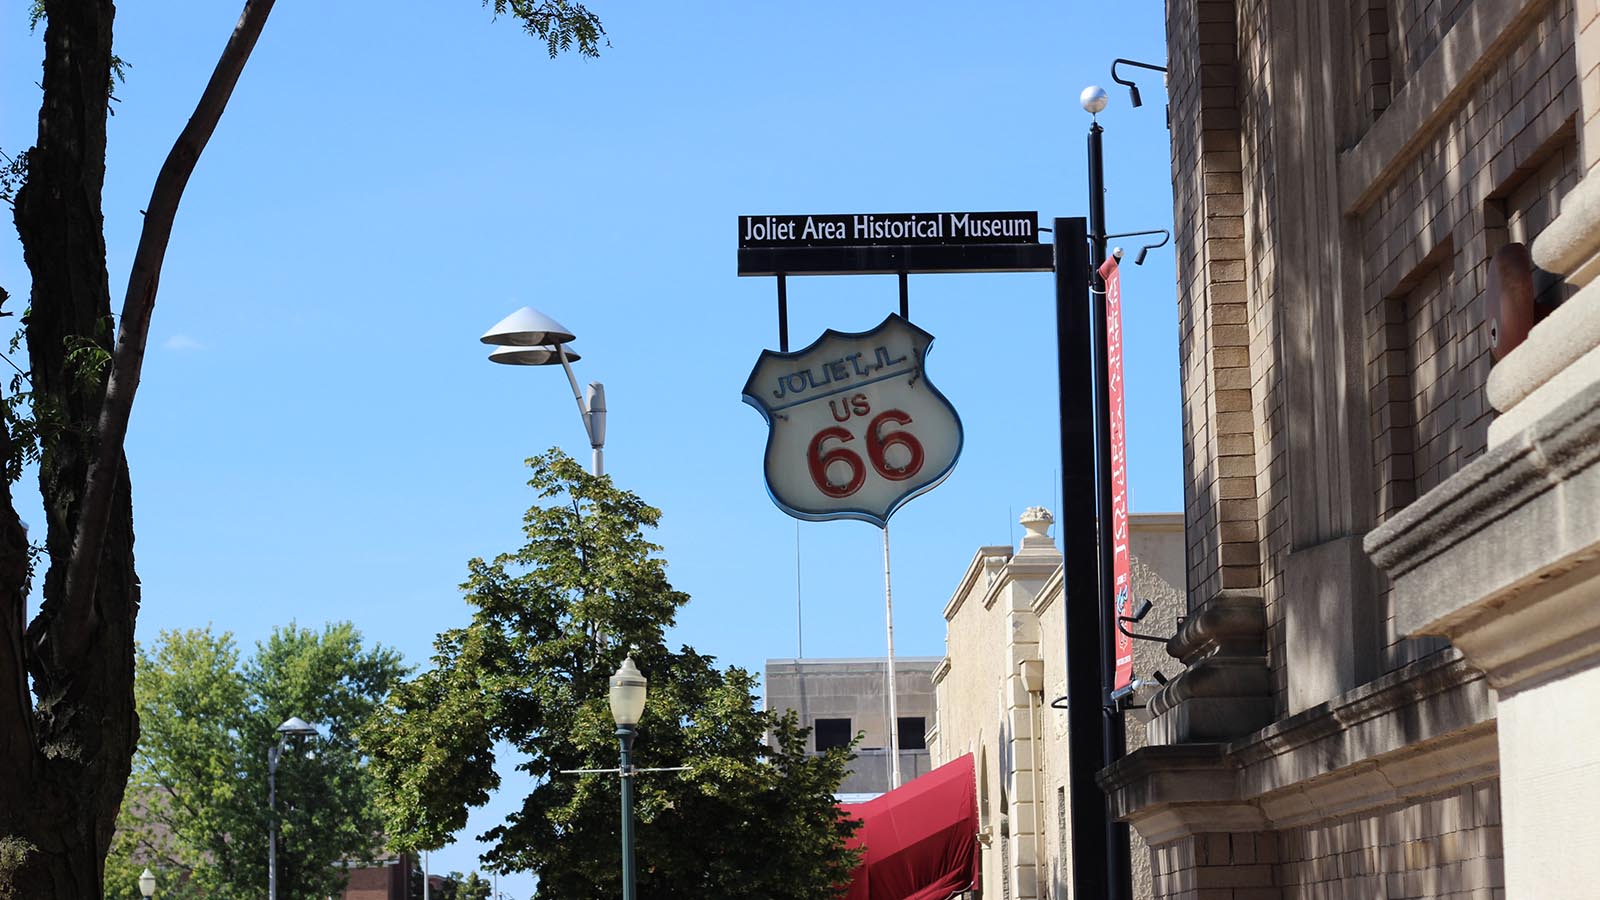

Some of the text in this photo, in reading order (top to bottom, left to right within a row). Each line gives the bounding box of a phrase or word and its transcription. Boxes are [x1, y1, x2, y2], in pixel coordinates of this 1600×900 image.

[745, 214, 1032, 240] Joliet Area Historical Museum
[875, 346, 907, 371] IL
[829, 393, 871, 422] US
[807, 409, 925, 498] 66
